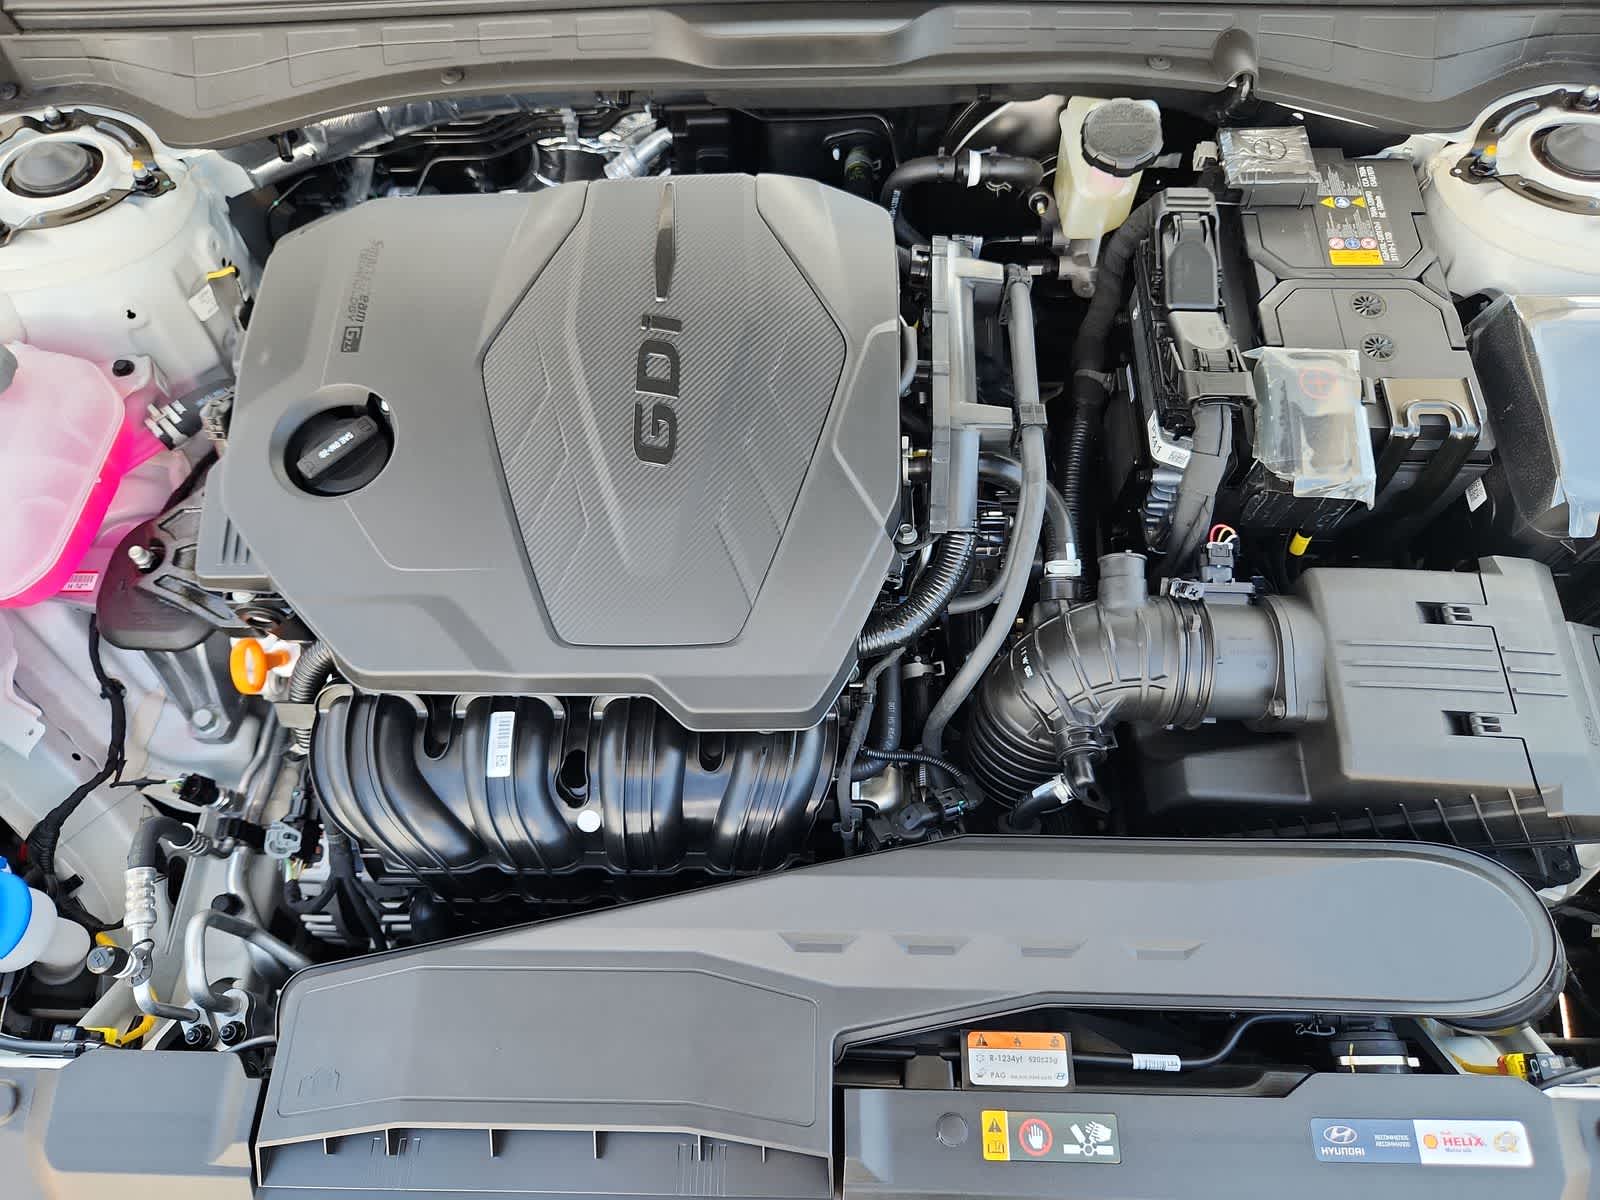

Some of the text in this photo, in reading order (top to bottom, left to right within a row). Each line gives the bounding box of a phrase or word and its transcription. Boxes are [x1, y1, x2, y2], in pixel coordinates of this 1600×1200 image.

[633, 313, 683, 466] GDi
[1442, 1136, 1484, 1147] HELIX
[1320, 1146, 1365, 1157] HYUNDAI
